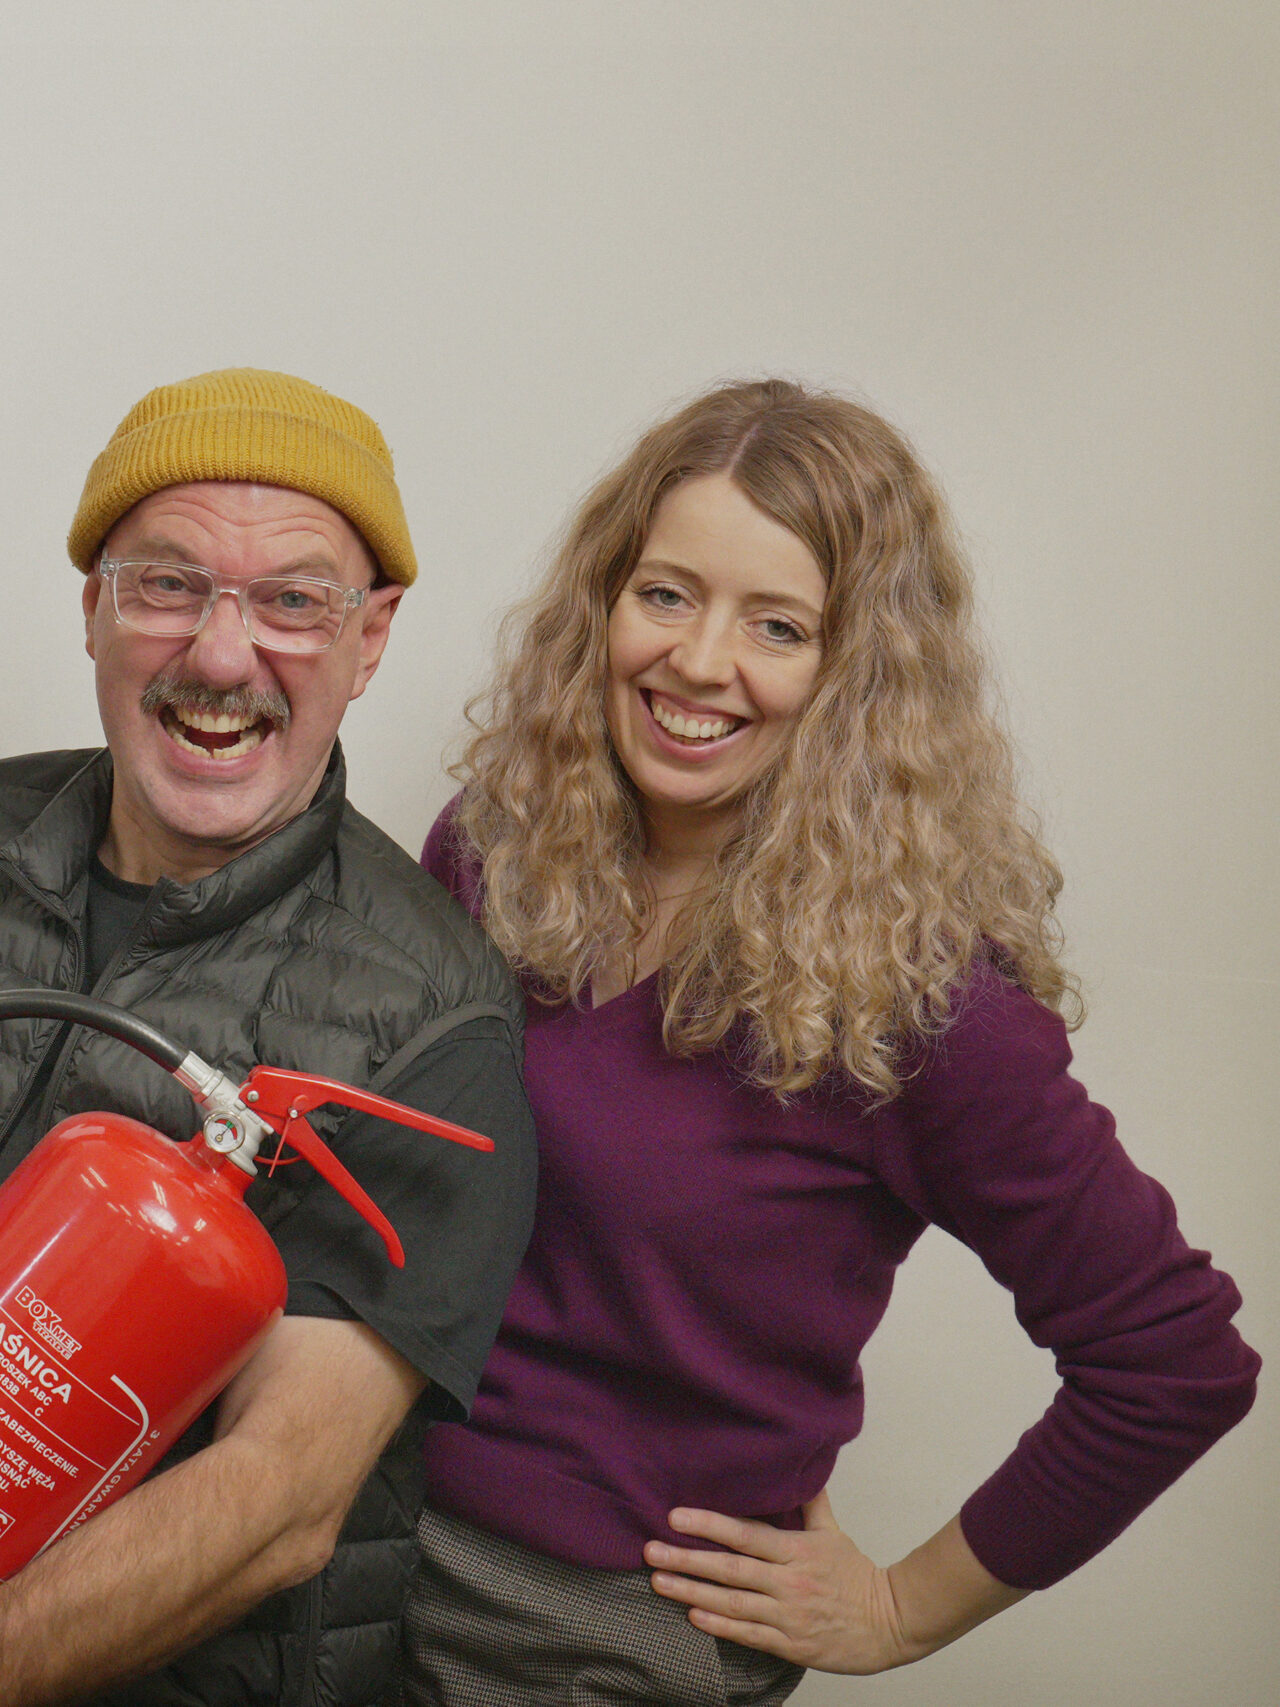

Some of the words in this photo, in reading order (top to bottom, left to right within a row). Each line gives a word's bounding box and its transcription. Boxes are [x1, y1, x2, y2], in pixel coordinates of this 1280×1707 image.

[33, 1321, 73, 1360] TRADE
[30, 1387, 52, 1406] ABC
[35, 1407, 44, 1416] C
[119, 1440, 151, 1472] LATA
[28, 1466, 55, 1490] WĘŻA
